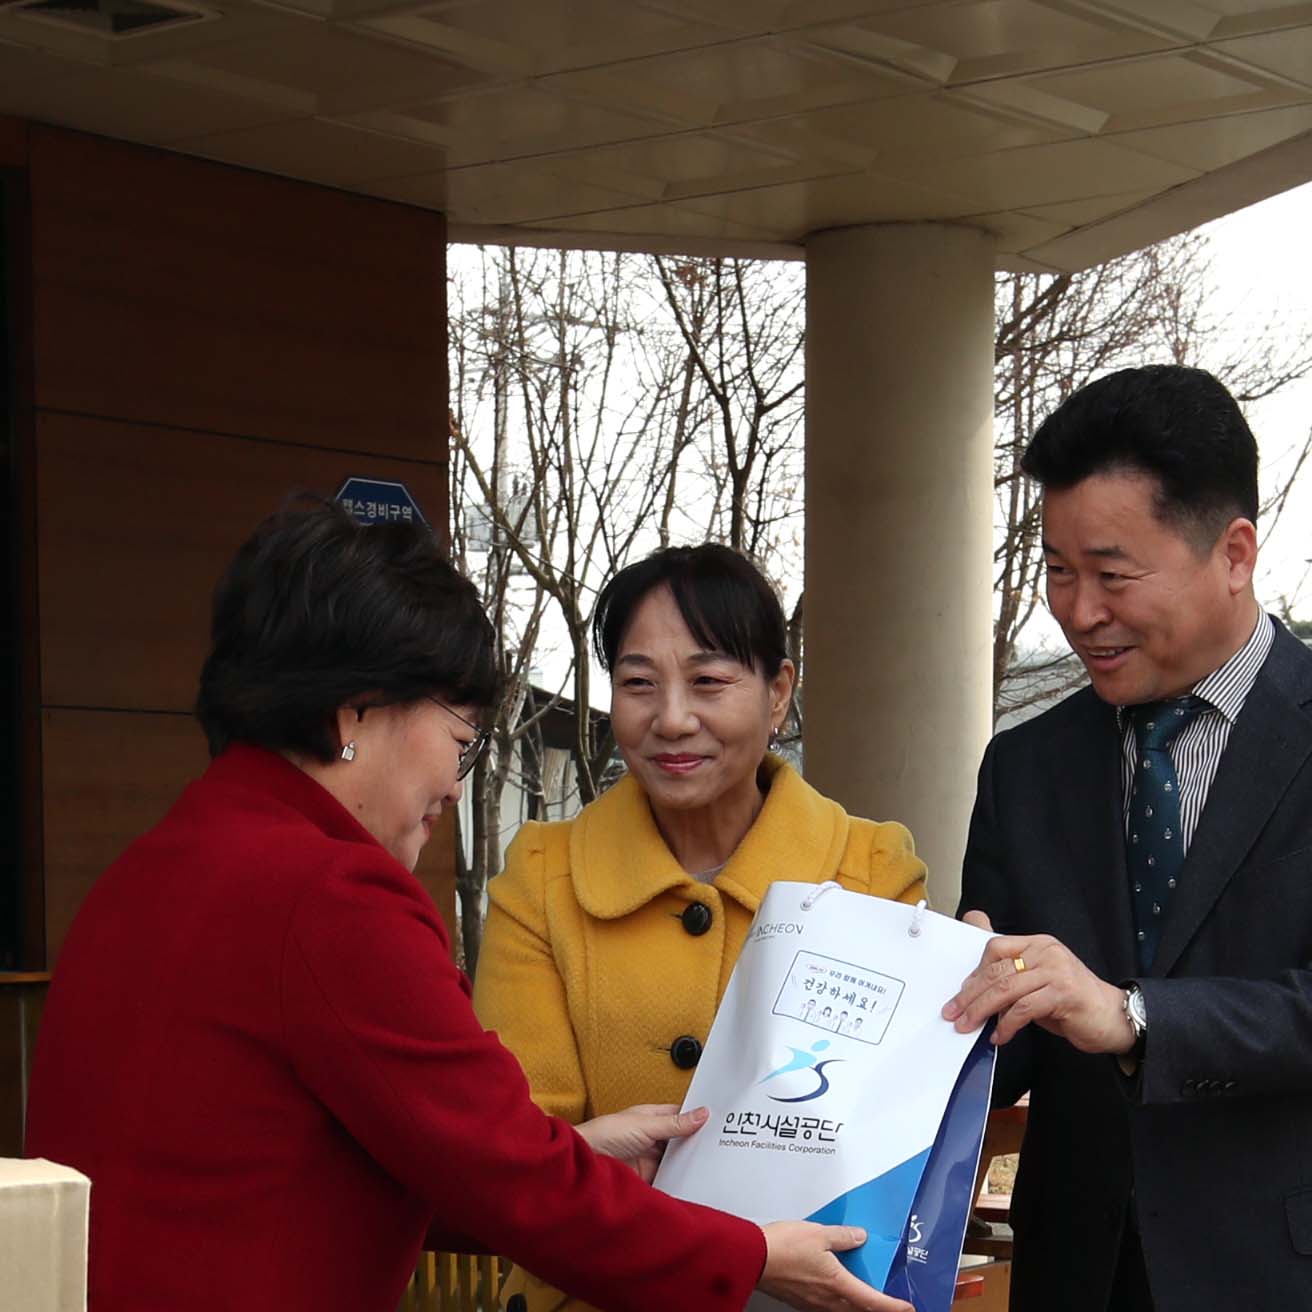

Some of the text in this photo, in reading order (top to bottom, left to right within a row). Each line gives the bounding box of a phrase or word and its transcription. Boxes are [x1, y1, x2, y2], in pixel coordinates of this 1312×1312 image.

[803, 977, 878, 1013] 건강하세요!
[723, 1111, 844, 1142] 인천시설공단
[719, 1139, 836, 1155] Incheon Facilities Corporation
